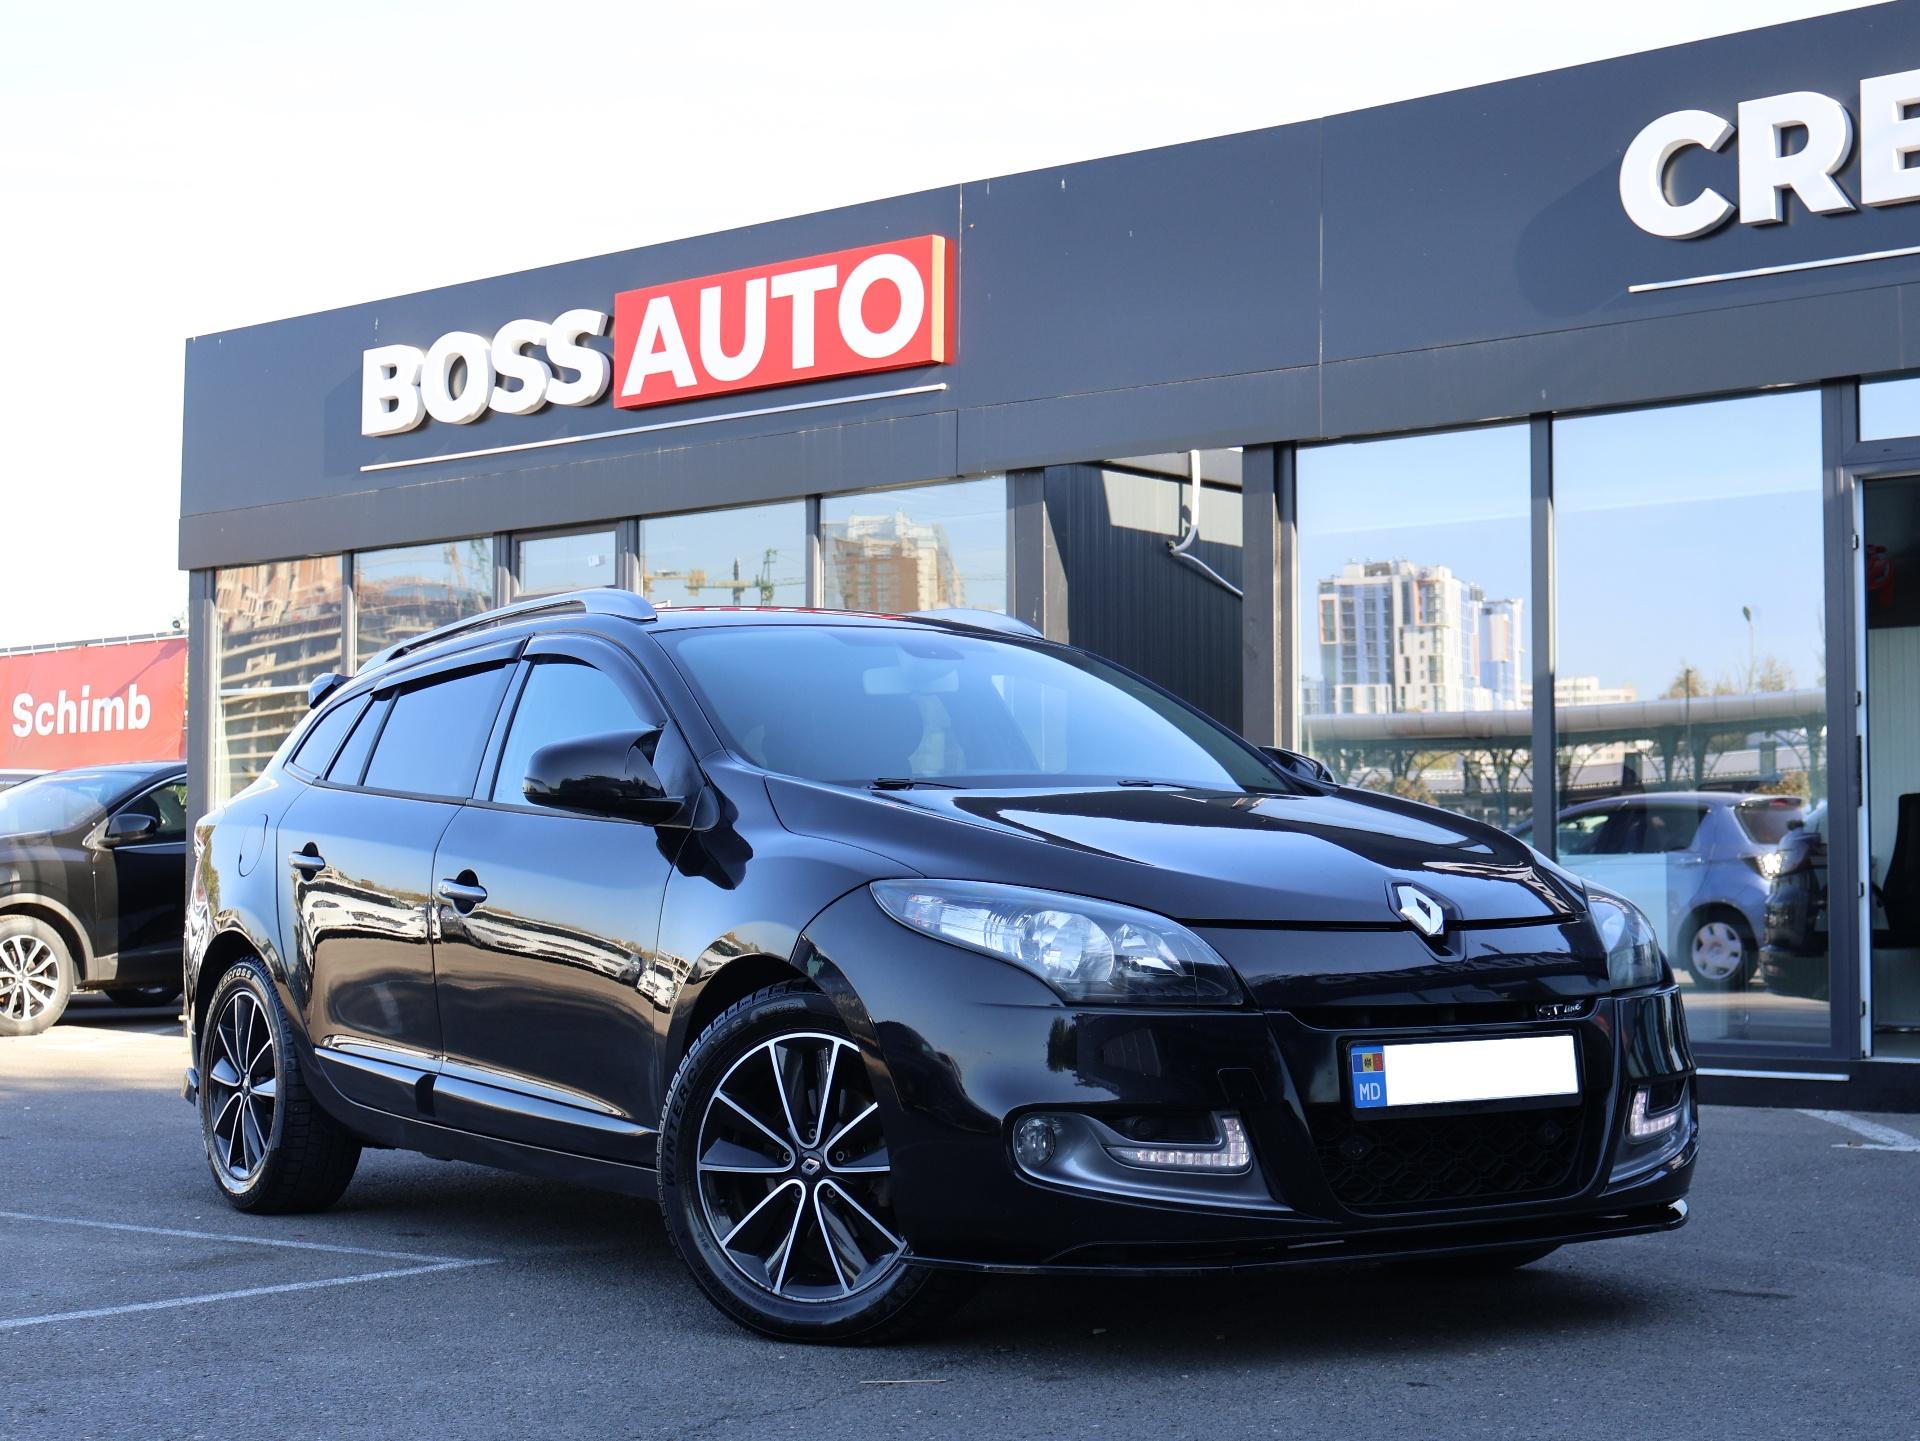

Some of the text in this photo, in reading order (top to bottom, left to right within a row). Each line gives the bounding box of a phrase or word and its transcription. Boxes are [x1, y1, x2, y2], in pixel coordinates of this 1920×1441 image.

[1619, 69, 1920, 240] CRE
[361, 253, 925, 437] BOSS AUTO
[12, 683, 151, 738] Schimb
[1359, 1082, 1381, 1101] MD
